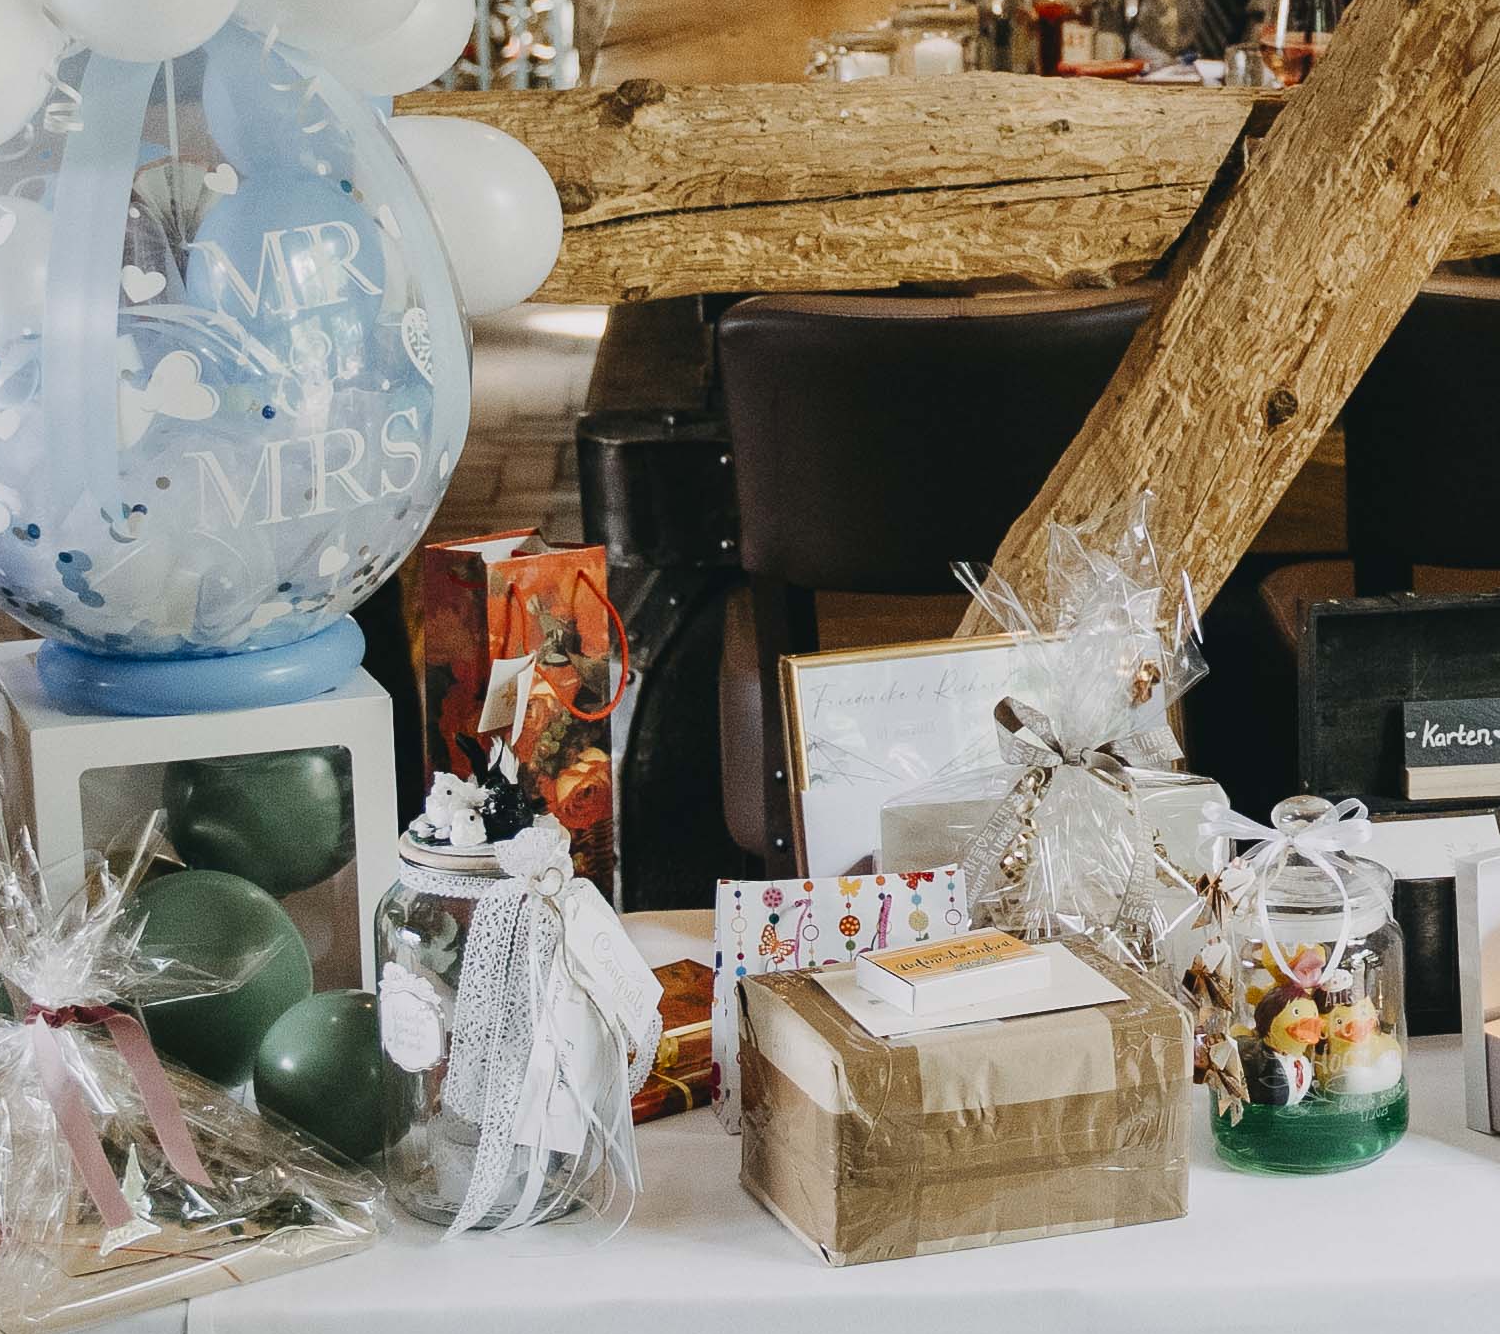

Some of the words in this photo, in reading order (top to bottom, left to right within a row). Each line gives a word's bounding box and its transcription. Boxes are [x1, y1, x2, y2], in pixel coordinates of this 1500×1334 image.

[187, 220, 383, 318] MR
[180, 406, 423, 529] MRS
[1422, 720, 1494, 749] Karten
